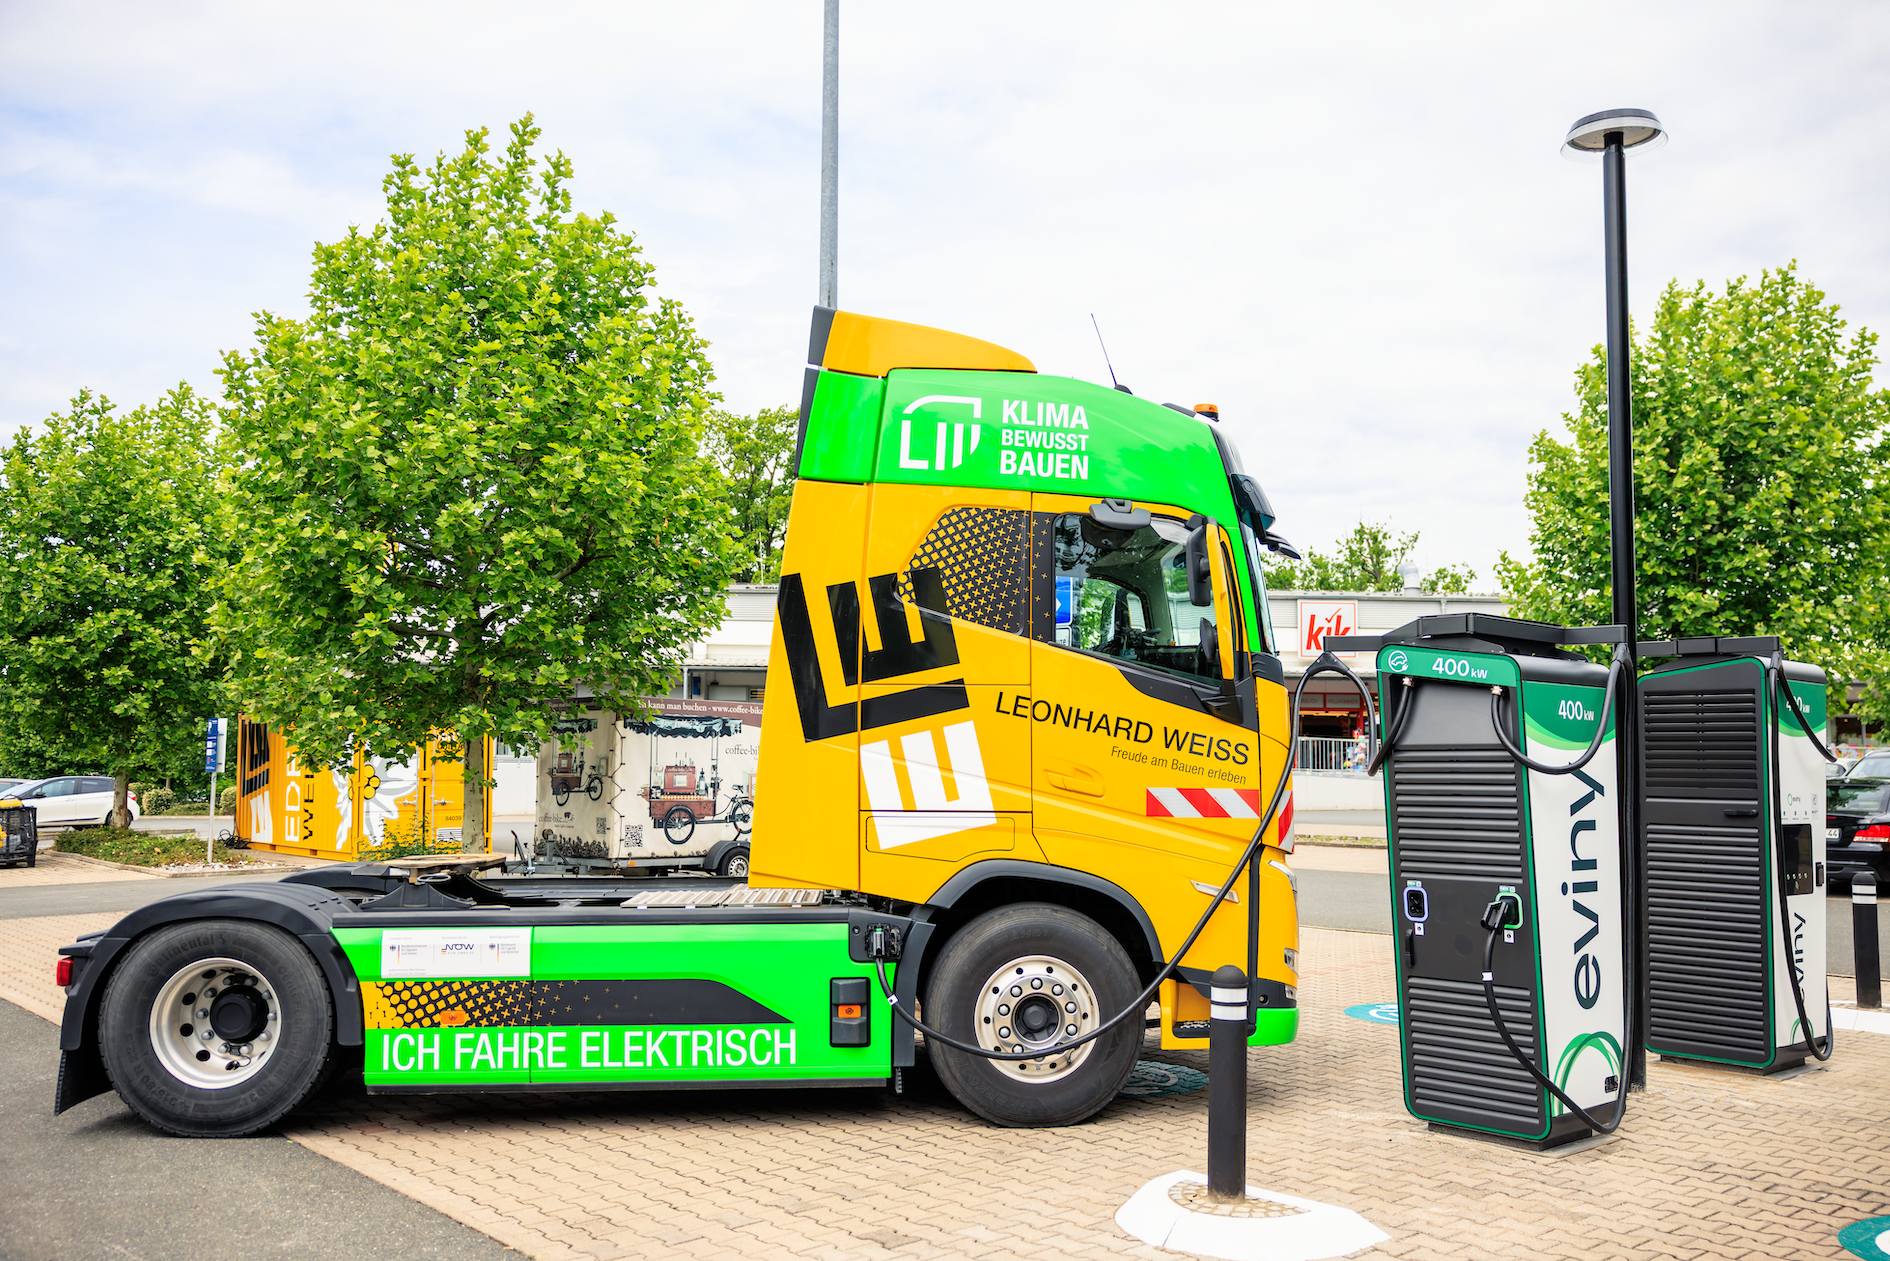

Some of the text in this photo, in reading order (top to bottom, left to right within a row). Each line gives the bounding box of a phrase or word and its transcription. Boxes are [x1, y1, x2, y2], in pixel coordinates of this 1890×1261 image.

[1002, 399, 1089, 430] KLIMA
[1001, 428, 1089, 451] BEWUSST
[1000, 449, 1089, 480] BAUEN
[1432, 657, 1488, 679] 400 kW
[648, 700, 665, 709] kann
[683, 702, 707, 711] buchen
[1558, 700, 1595, 721] 400 kW
[1786, 695, 1803, 712] 40
[996, 692, 1249, 765] LEONHARD WEISS
[1111, 746, 1247, 785] Freude am Bauen erleben
[1561, 761, 1604, 1009] eviny
[146, 934, 215, 978] Continental
[382, 1028, 796, 1071] ICH FAHRE ELEKTRISCH
